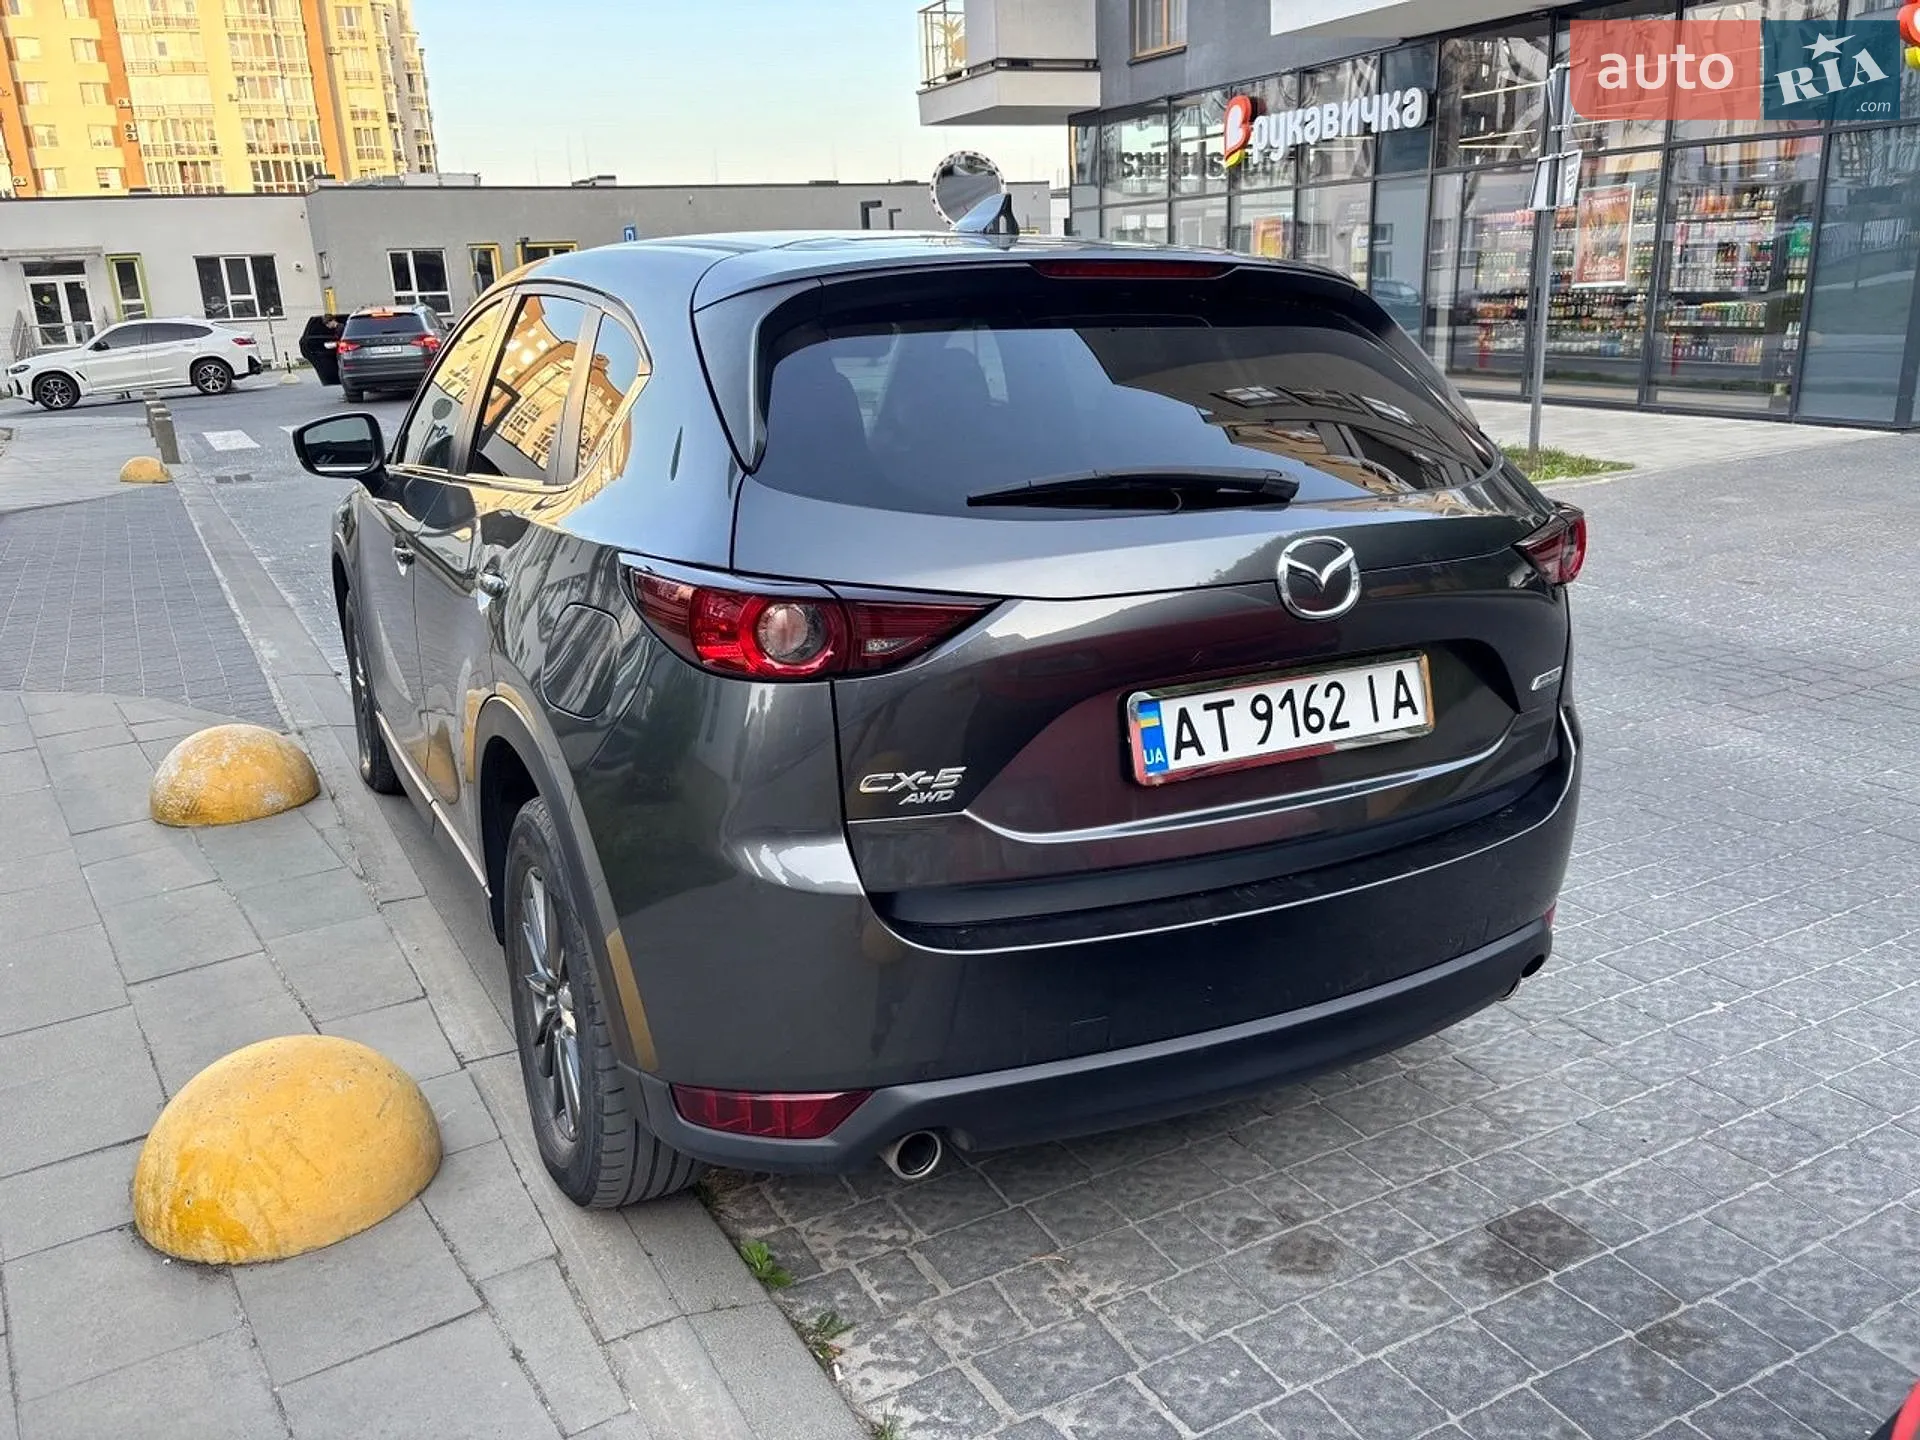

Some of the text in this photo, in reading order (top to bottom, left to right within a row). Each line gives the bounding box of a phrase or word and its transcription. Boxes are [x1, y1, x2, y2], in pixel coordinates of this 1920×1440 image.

[1252, 87, 1426, 164] рукавичка
[1173, 669, 1419, 760] AT 9162 IA
[1144, 747, 1166, 765] UA
[859, 766, 967, 793] CX-5
[898, 789, 955, 806] AWD
